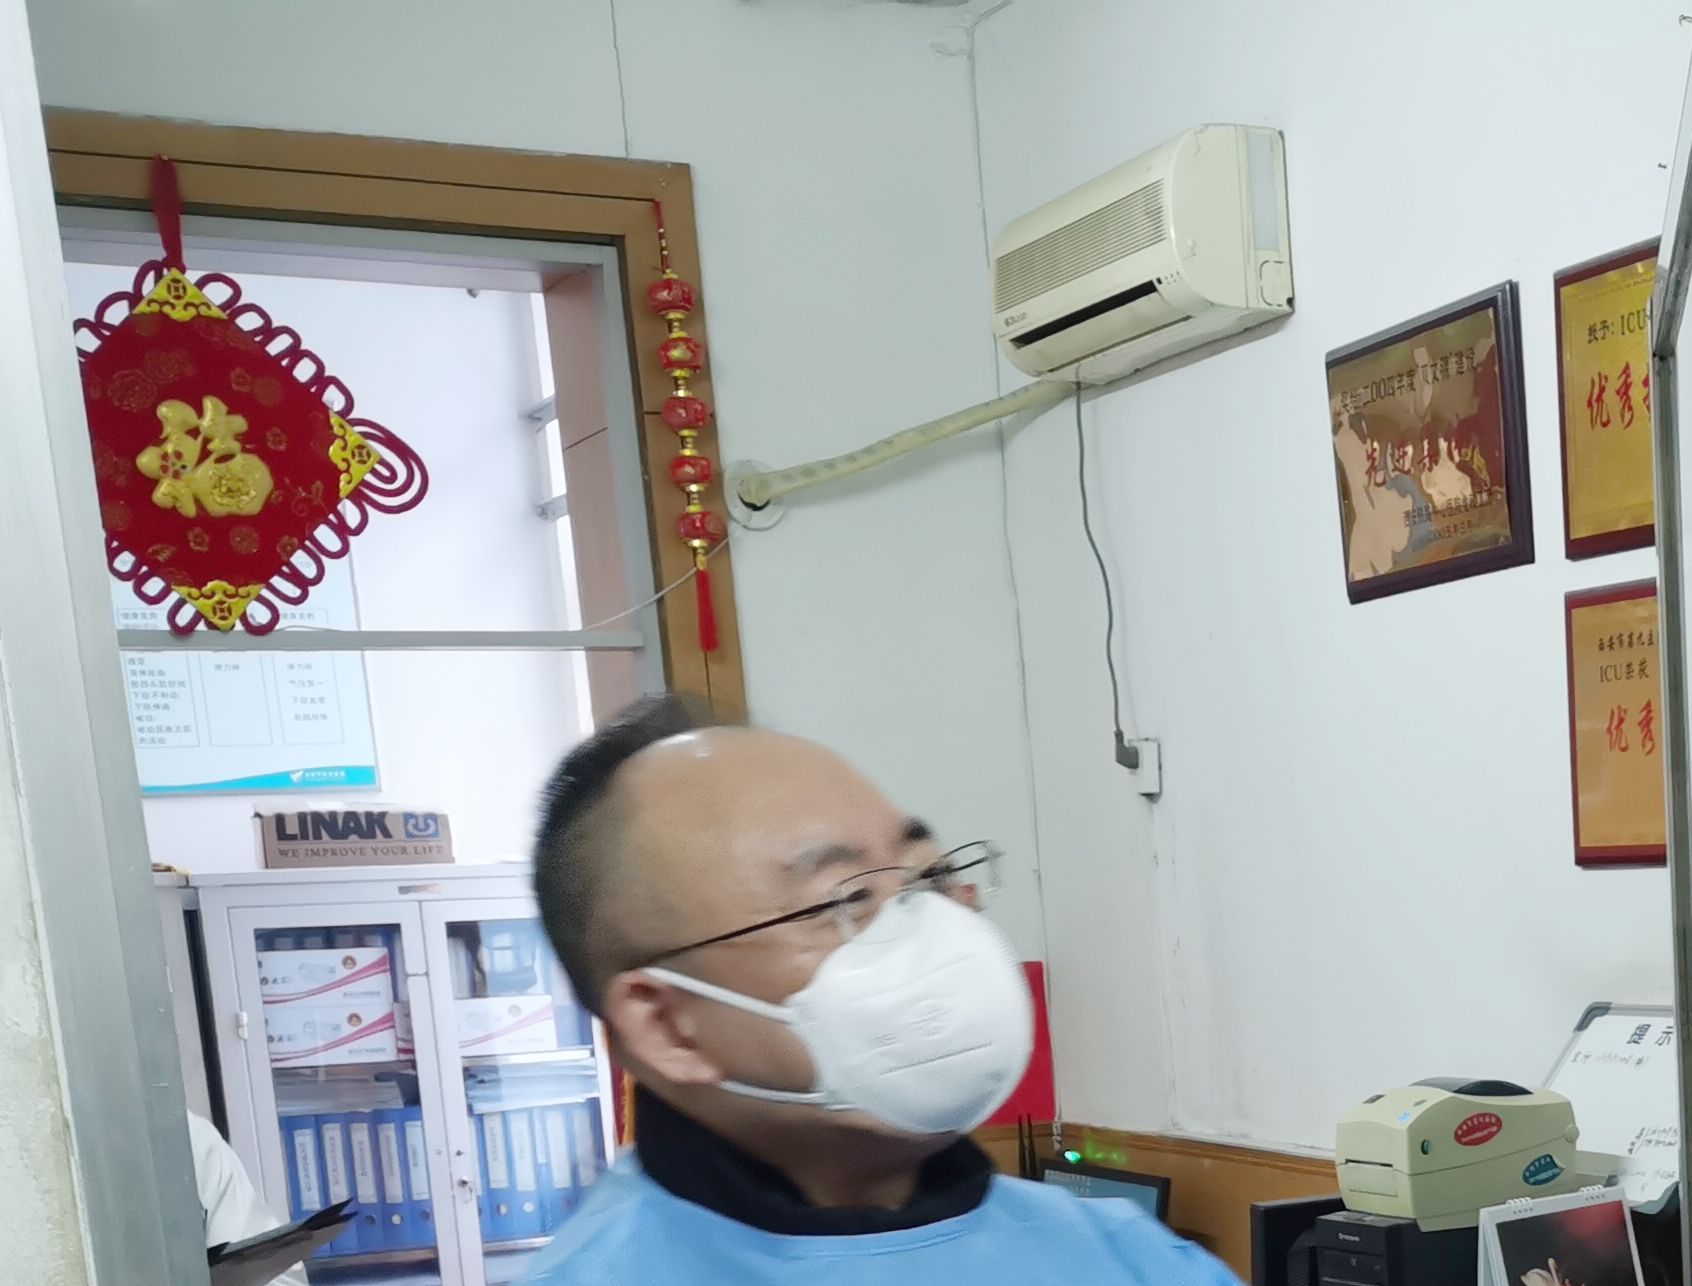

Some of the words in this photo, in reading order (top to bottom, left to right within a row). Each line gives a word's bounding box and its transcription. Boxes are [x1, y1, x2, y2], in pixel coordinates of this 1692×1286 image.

[135, 394, 274, 519] 福
[1606, 698, 1656, 757] 优秀
[276, 810, 394, 842] LINAK
[278, 848, 300, 859] WE
[304, 846, 369, 858] IMPROVE
[370, 845, 410, 857] YOUR
